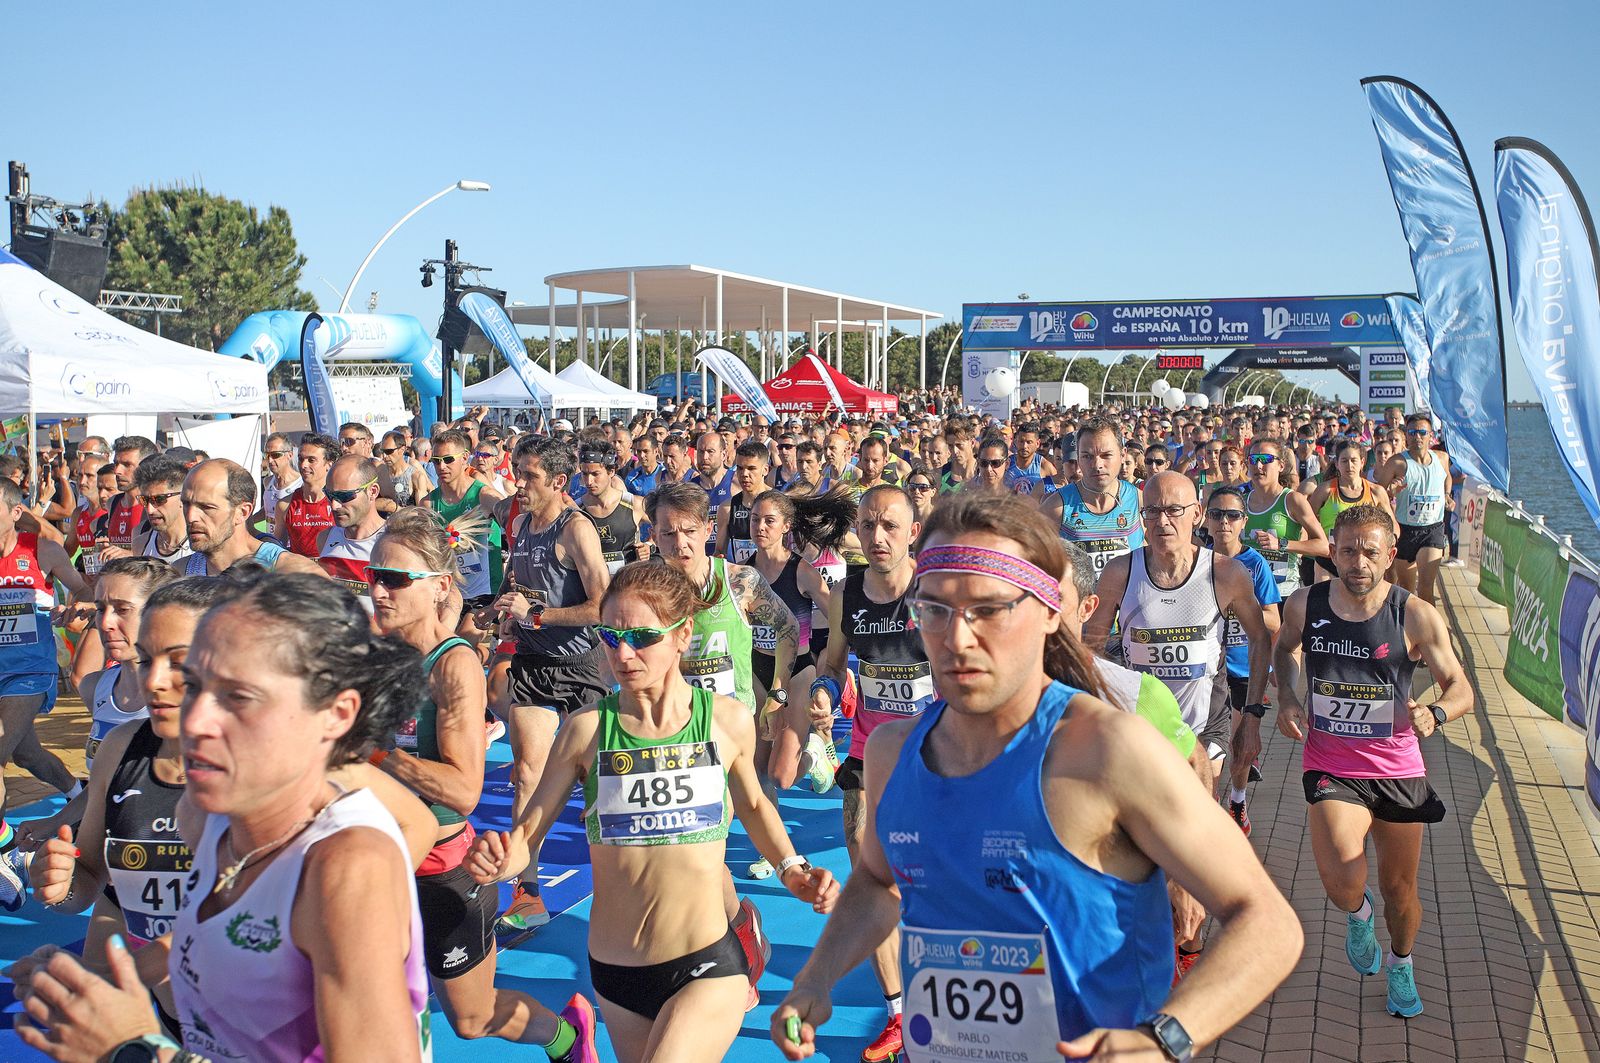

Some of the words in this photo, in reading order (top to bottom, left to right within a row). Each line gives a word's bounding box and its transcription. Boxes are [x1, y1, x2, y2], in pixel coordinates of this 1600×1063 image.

[1112, 305, 1213, 319] CAMPEONATO
[1029, 311, 1053, 343] 10
[1112, 322, 1128, 333] de
[1131, 319, 1181, 333] ESPAÑA
[1190, 318, 1212, 334] 10
[1218, 317, 1249, 333] km
[1262, 306, 1289, 340] 10
[1288, 313, 1331, 325] HUELVA
[1073, 332, 1095, 340] WiHu
[1178, 334, 1212, 342] Absoluto
[727, 402, 814, 412] SPOANIACS
[1414, 502, 1436, 511] 1711
[853, 619, 866, 634] 26
[868, 617, 905, 634] millas
[1155, 627, 1198, 635] RUNNING
[1147, 645, 1189, 664] 360
[1310, 636, 1324, 652] 26
[1327, 639, 1370, 659] millas
[690, 657, 724, 667] UNNING
[880, 665, 920, 673] RUNNING
[695, 666, 719, 675] LOOP
[875, 681, 914, 700] 210
[1339, 685, 1385, 694] RUNNING
[1328, 700, 1372, 721] 277
[641, 745, 706, 759] RUNNG
[659, 758, 697, 770] LOOP
[627, 774, 695, 809] 485
[141, 877, 181, 912] 41
[907, 934, 926, 968] 10
[924, 943, 957, 958] HUELVA
[990, 945, 1030, 968] 2023
[442, 954, 470, 969] luanvi
[922, 975, 1024, 1026] 1629
[957, 1032, 991, 1044] PABLO
[985, 1049, 1029, 1062] MATEOS
